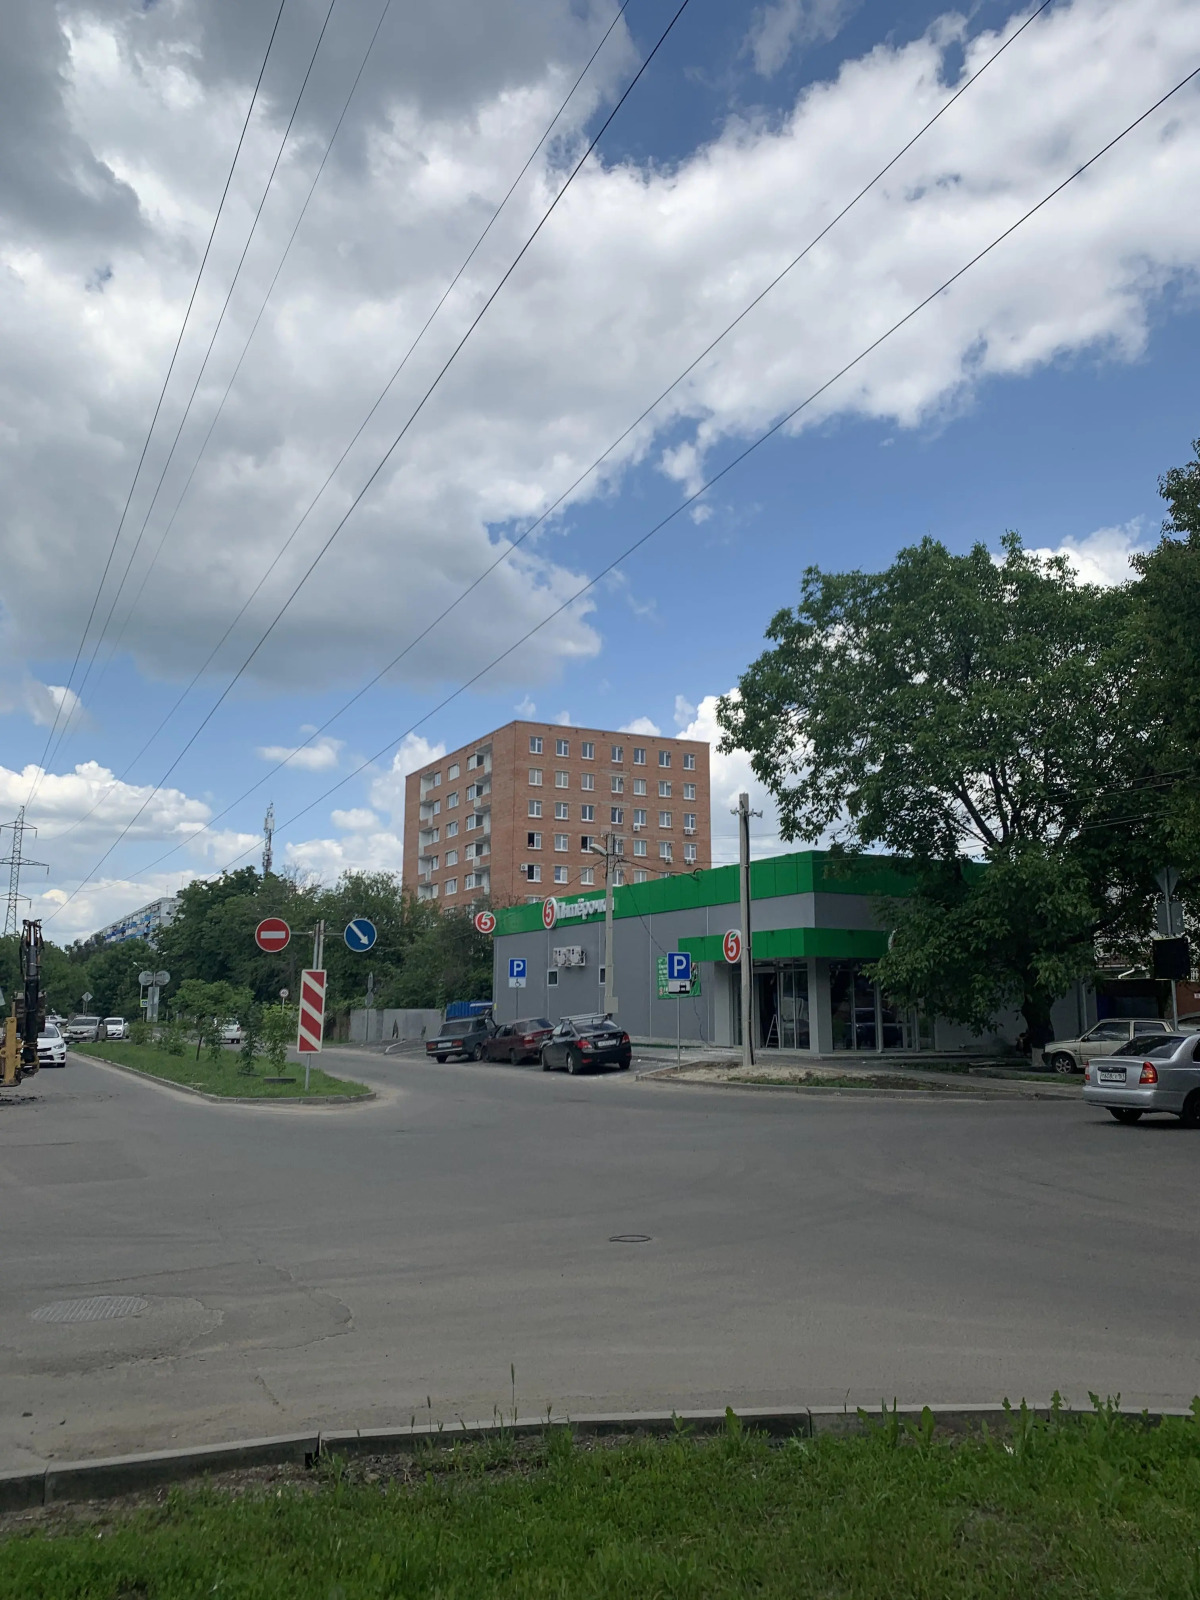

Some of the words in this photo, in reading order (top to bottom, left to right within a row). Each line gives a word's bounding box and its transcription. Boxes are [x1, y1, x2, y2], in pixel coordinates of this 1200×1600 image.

[556, 897, 615, 920] Пятёрочк
[727, 932, 738, 958] 5
[513, 960, 524, 977] P
[673, 955, 687, 977] P
